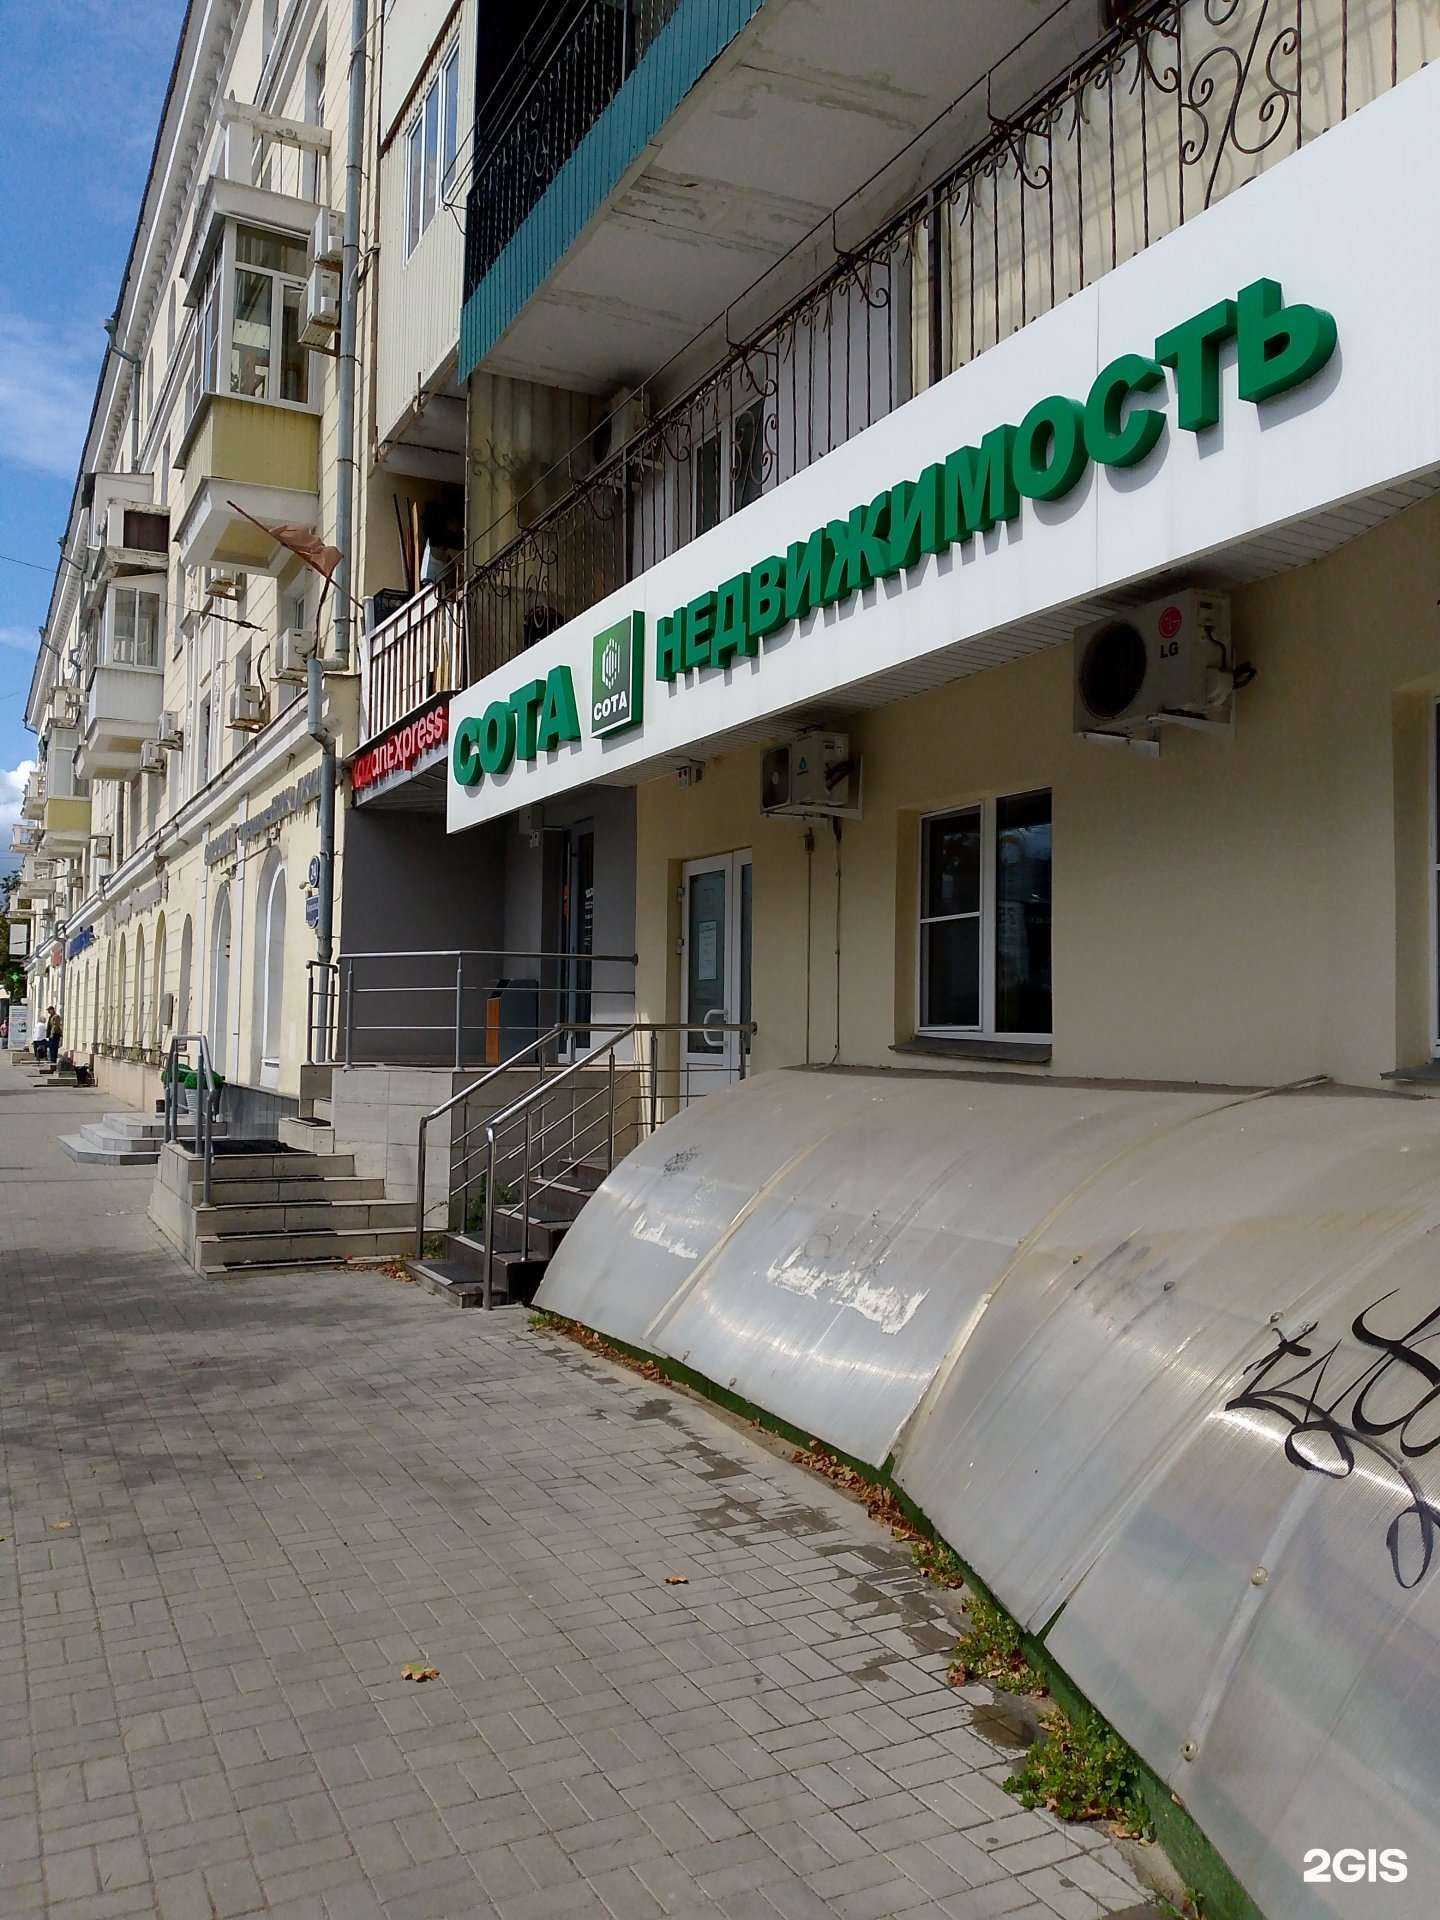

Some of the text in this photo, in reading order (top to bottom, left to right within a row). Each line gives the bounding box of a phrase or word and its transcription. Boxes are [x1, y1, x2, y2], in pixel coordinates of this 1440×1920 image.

[453, 277, 1337, 786] СОТА НЕДВИЖИМОСТЬ
[1160, 641, 1179, 659] LG
[593, 690, 628, 721] СОТА
